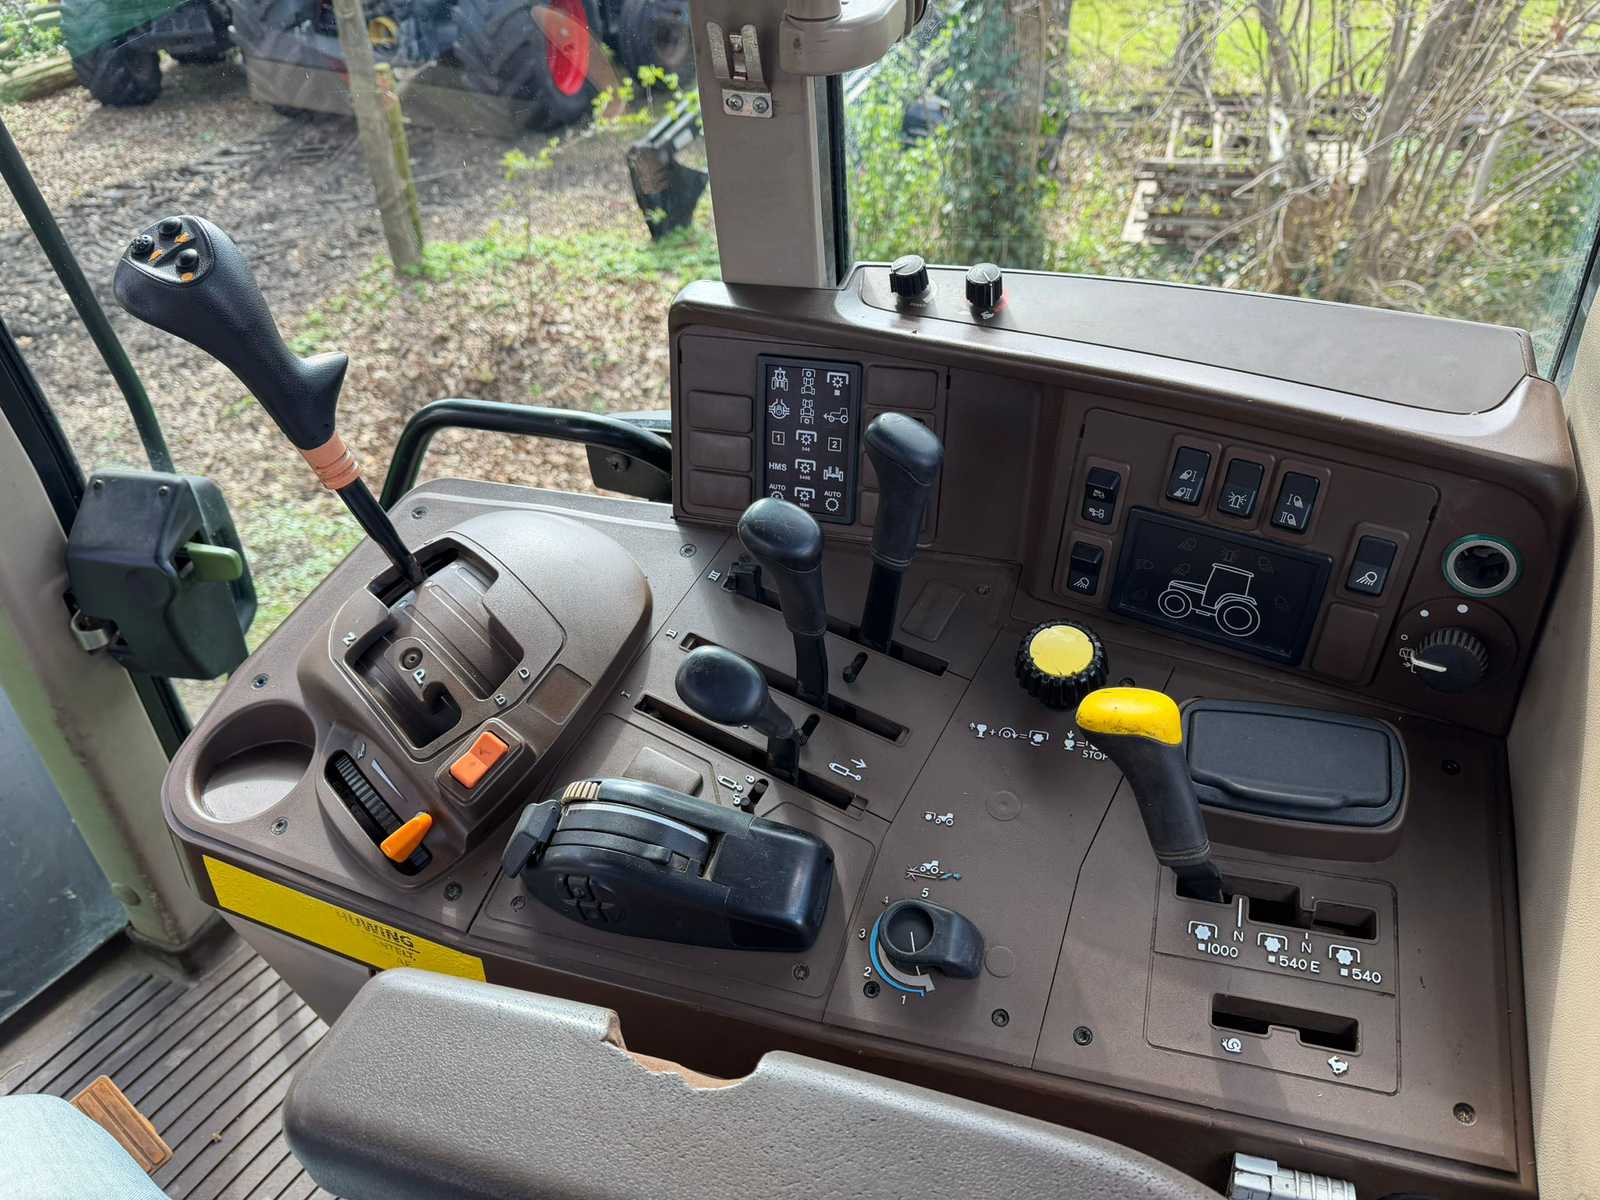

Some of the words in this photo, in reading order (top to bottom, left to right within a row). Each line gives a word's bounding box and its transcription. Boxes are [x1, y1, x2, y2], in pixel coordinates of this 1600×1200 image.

[832, 441, 838, 449] 2
[768, 462, 787, 471] HMS
[769, 483, 786, 491] AUTO
[824, 490, 842, 498] AUTO
[413, 668, 426, 687] P
[518, 667, 530, 679] D
[921, 888, 929, 897] 5
[859, 928, 866, 938] 3
[1233, 930, 1244, 942] N
[1207, 942, 1239, 958] 1000
[1301, 941, 1312, 954] N
[864, 966, 872, 977] 2
[1352, 969, 1382, 984] 540
[901, 995, 906, 1004] 1
